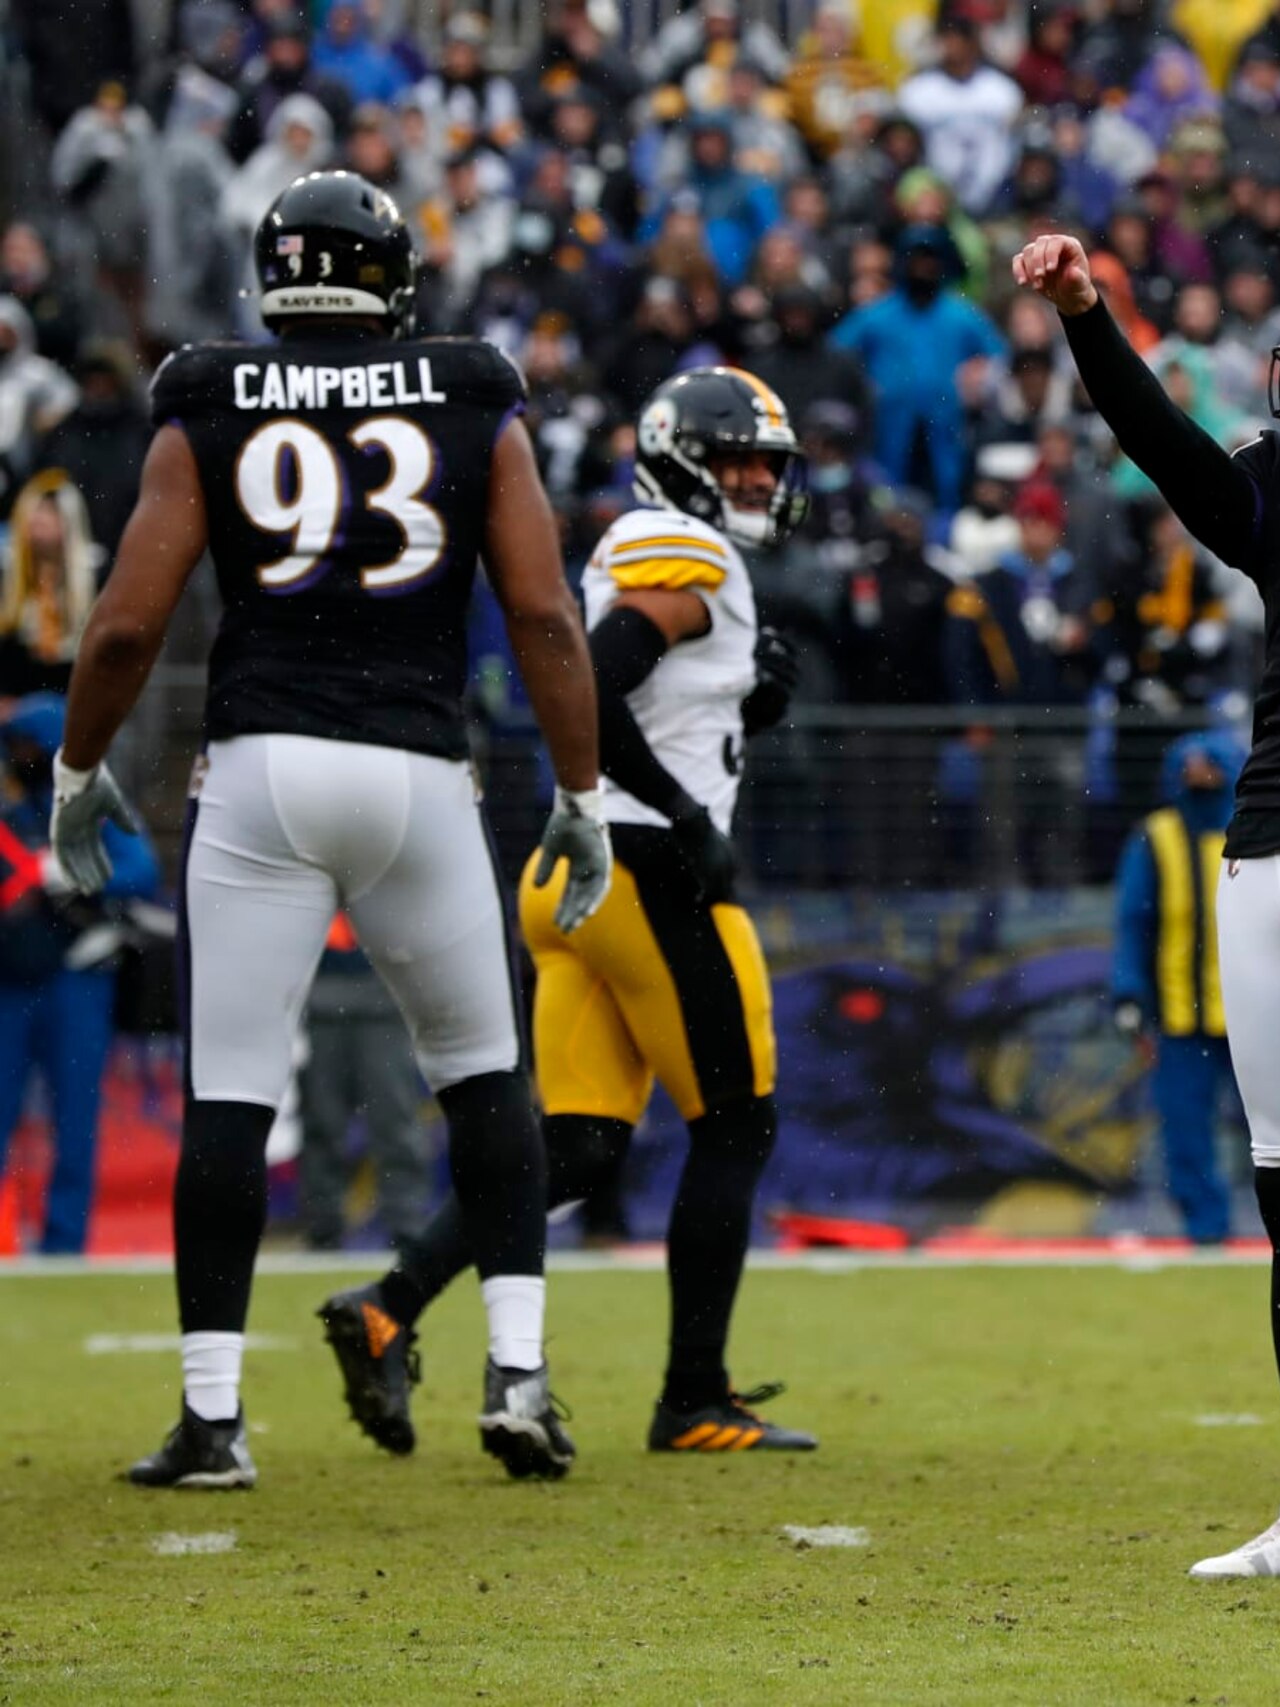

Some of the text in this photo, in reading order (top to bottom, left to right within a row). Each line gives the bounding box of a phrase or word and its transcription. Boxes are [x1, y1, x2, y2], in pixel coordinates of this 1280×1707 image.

[278, 296, 353, 308] RAVENS
[233, 357, 447, 410] CAMPBELL
[234, 413, 453, 592] 93
